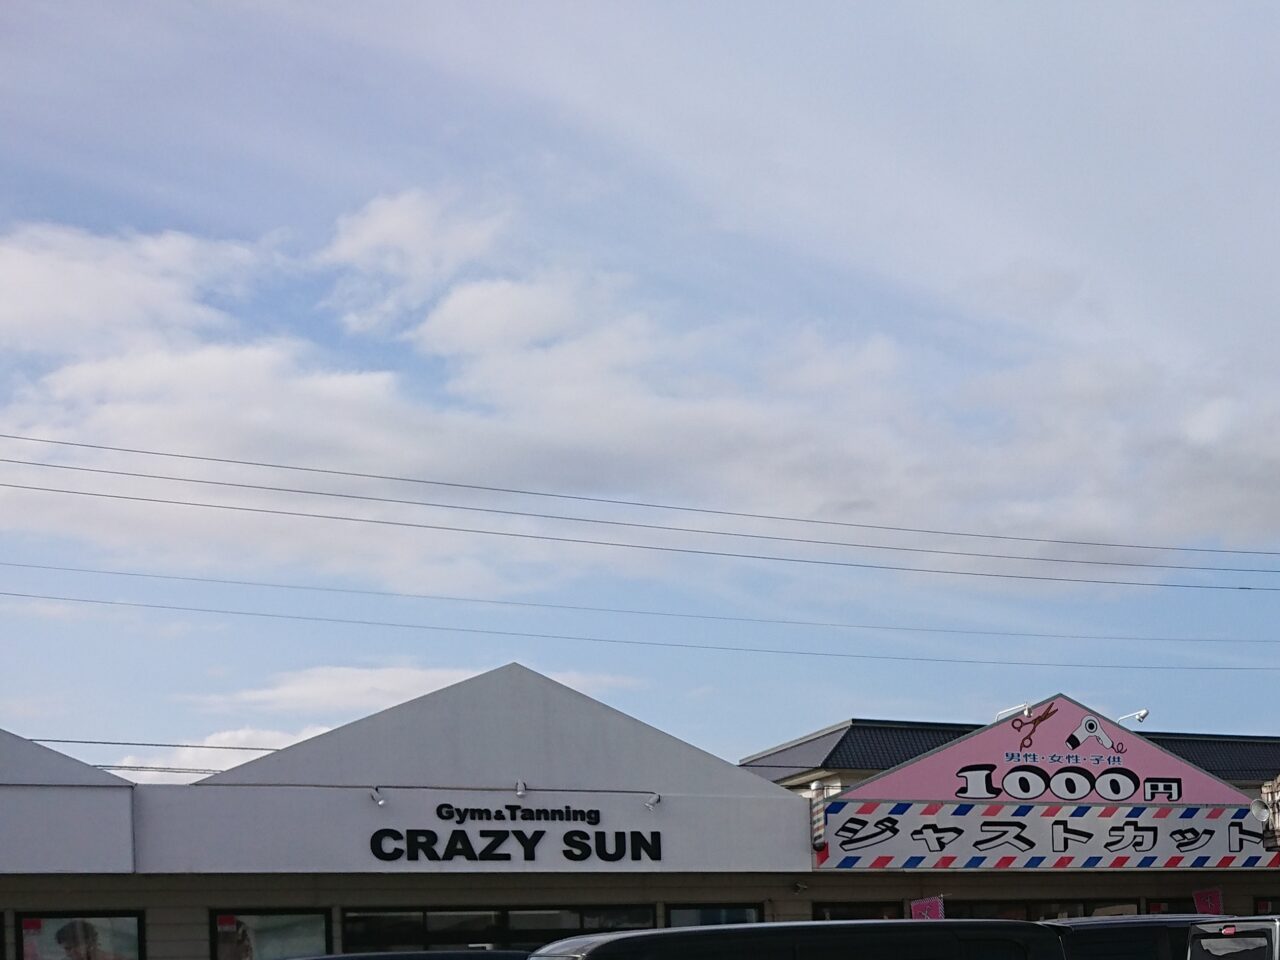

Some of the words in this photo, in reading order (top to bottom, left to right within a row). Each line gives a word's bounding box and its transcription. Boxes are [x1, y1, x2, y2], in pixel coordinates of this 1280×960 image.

[955, 764, 1182, 801] 1000円
[436, 803, 601, 826] Gym&Tanning
[370, 828, 546, 861] CRAZY
[562, 830, 662, 862] SUN
[835, 816, 1264, 854] ジャストカット
